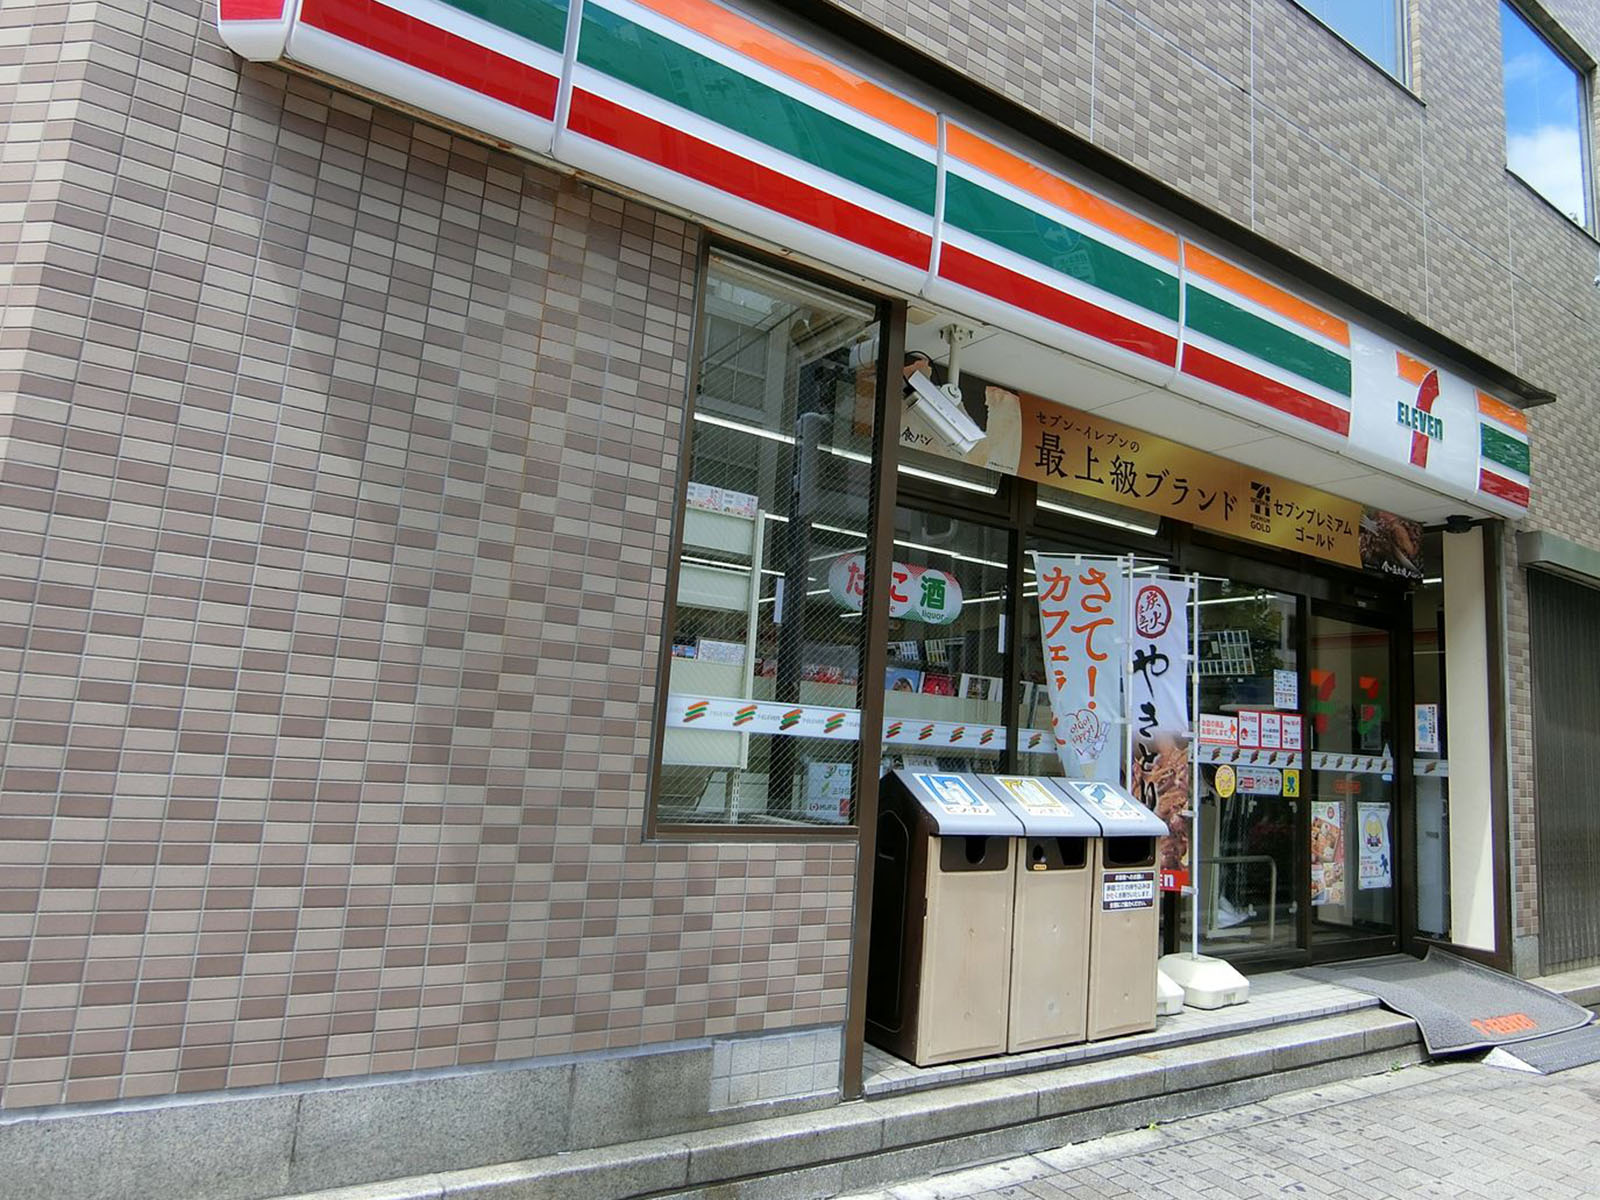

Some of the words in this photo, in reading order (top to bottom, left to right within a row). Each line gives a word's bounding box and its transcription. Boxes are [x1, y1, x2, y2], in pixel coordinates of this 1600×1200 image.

[1034, 431, 1238, 521] 最上級ブランド
[1250, 520, 1271, 534] GOLD
[1273, 498, 1353, 536] セブンプレミアム
[1295, 527, 1335, 551] ゴールド
[846, 561, 909, 603] たこ
[920, 575, 947, 610] 酒
[1132, 643, 1170, 813] やきとり
